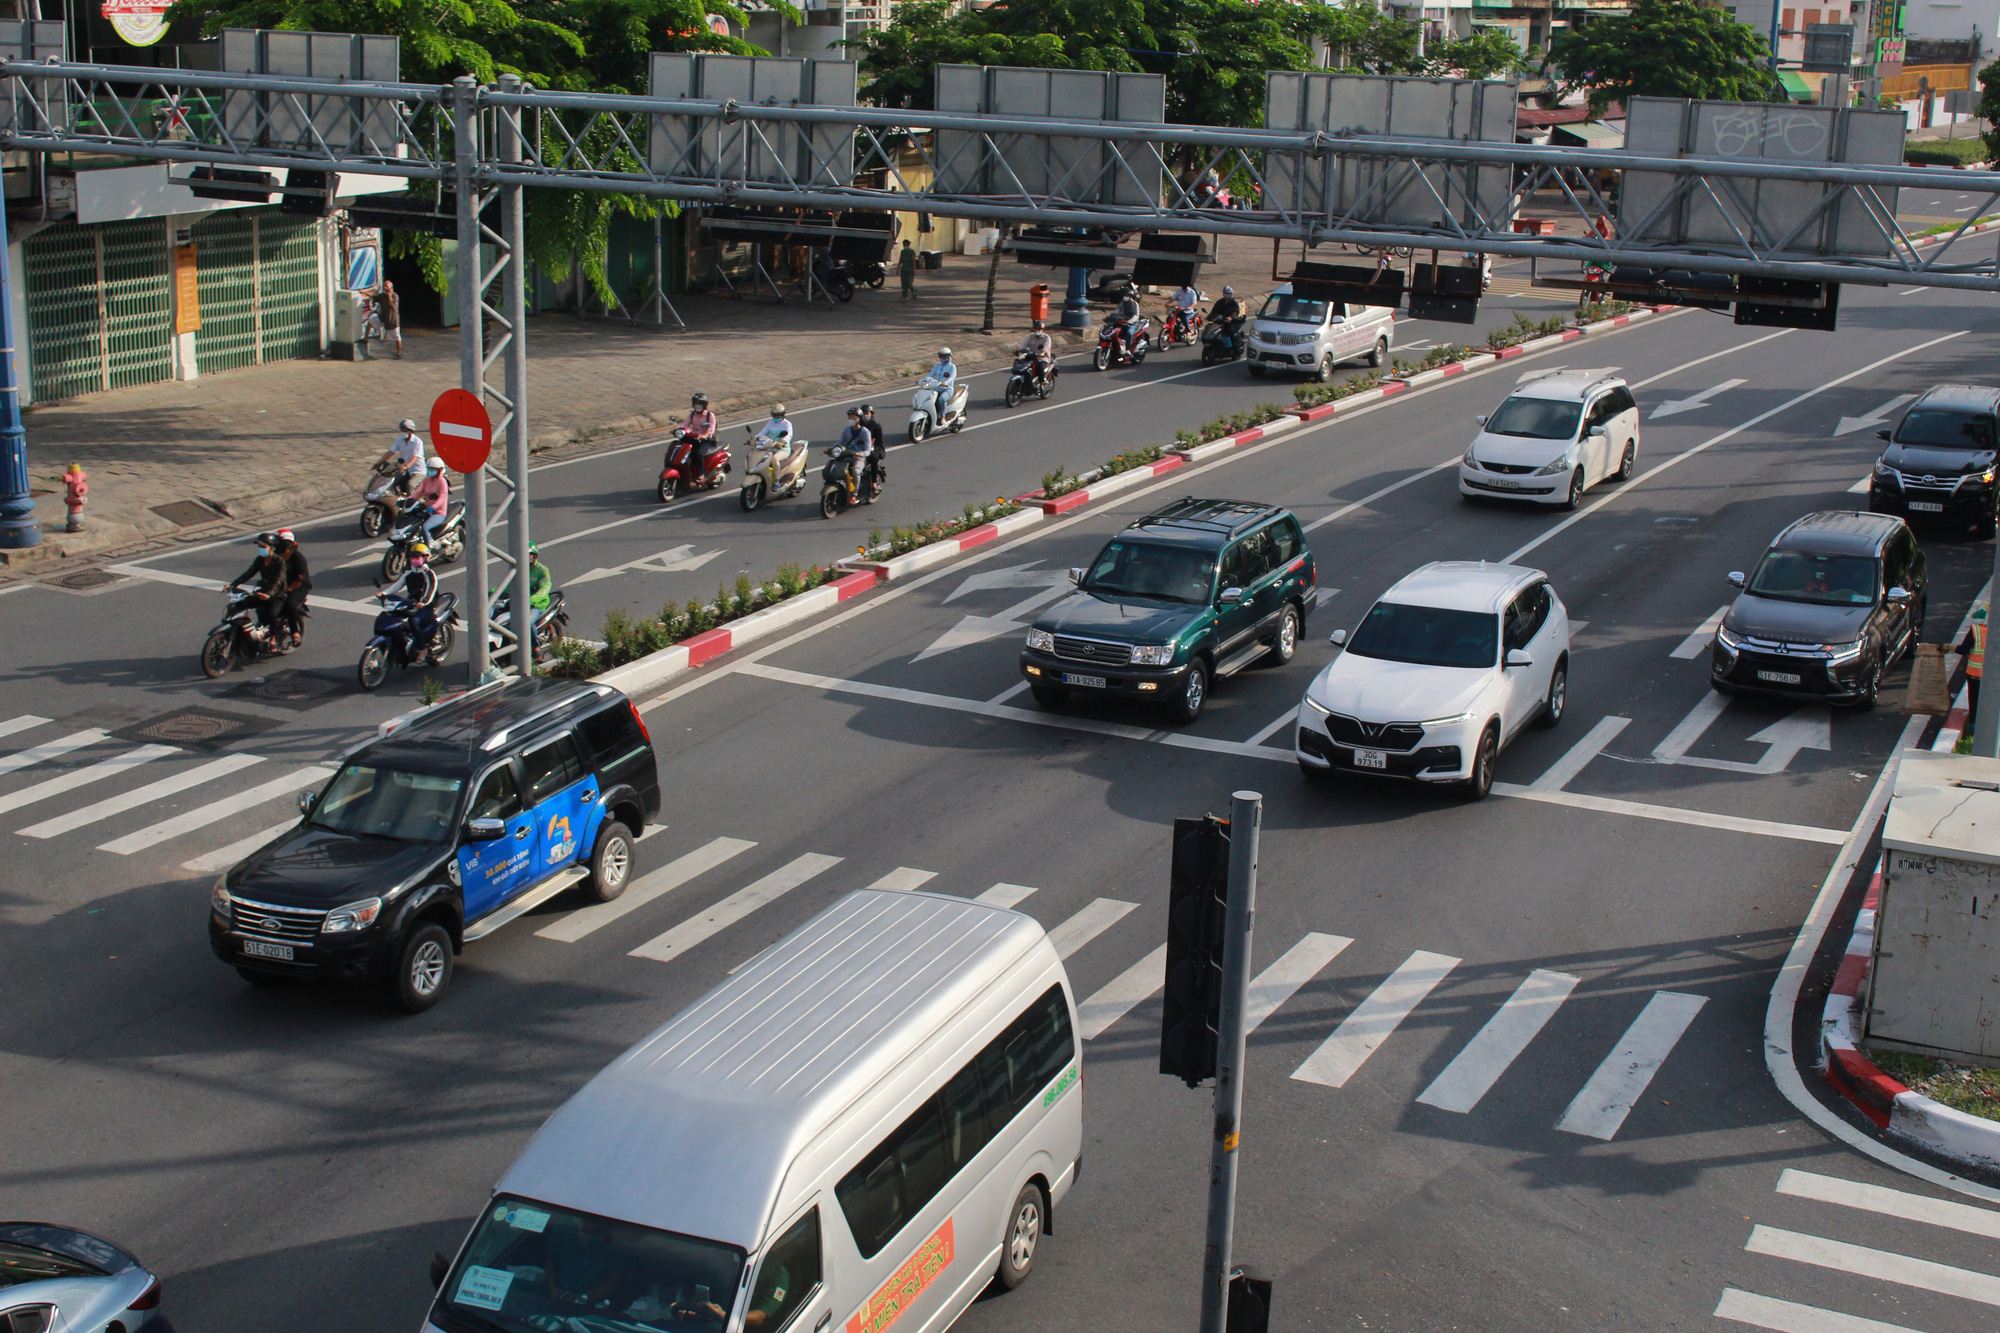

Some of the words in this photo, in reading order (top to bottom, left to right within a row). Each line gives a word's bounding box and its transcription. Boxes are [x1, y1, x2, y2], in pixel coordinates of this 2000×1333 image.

[1363, 751, 1378, 759] 30G
[465, 858, 479, 871] VIB
[485, 860, 507, 879] 30.000
[263, 921, 276, 929] Ford
[902, 1262, 913, 1281] XE
